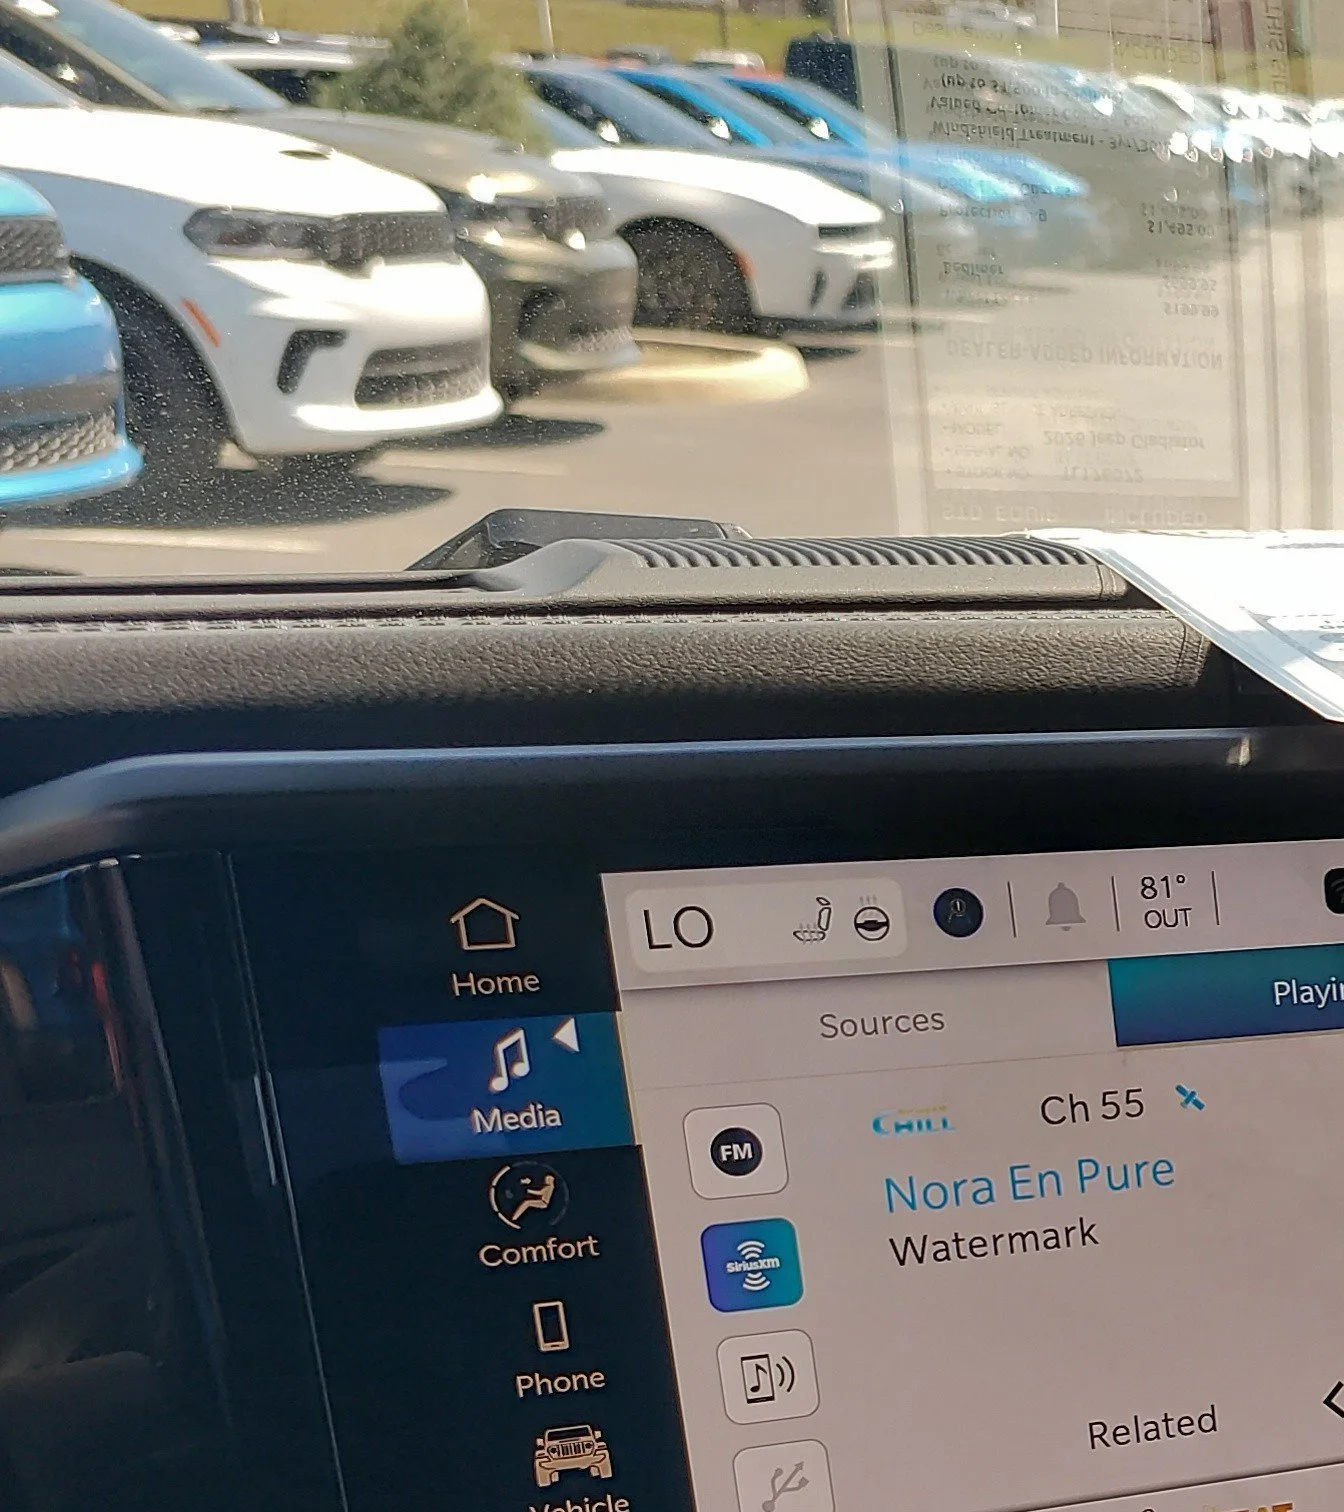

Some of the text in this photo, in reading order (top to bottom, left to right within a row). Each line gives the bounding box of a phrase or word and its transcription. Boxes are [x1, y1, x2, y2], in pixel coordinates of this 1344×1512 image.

[1140, 874, 1187, 901] 81°
[643, 905, 715, 953] LO
[1143, 907, 1193, 930] OUT
[453, 970, 540, 997] Home
[819, 1009, 946, 1039] Sources
[471, 1103, 562, 1134] Media
[1041, 1089, 1145, 1125] Ch 55
[720, 1142, 753, 1162] FM
[885, 1153, 1176, 1214] Nora En Pure
[478, 1235, 600, 1268] Comfort
[890, 1217, 1100, 1267] Watermark
[515, 1367, 606, 1398] Phone
[1089, 1405, 1218, 1450] Related
